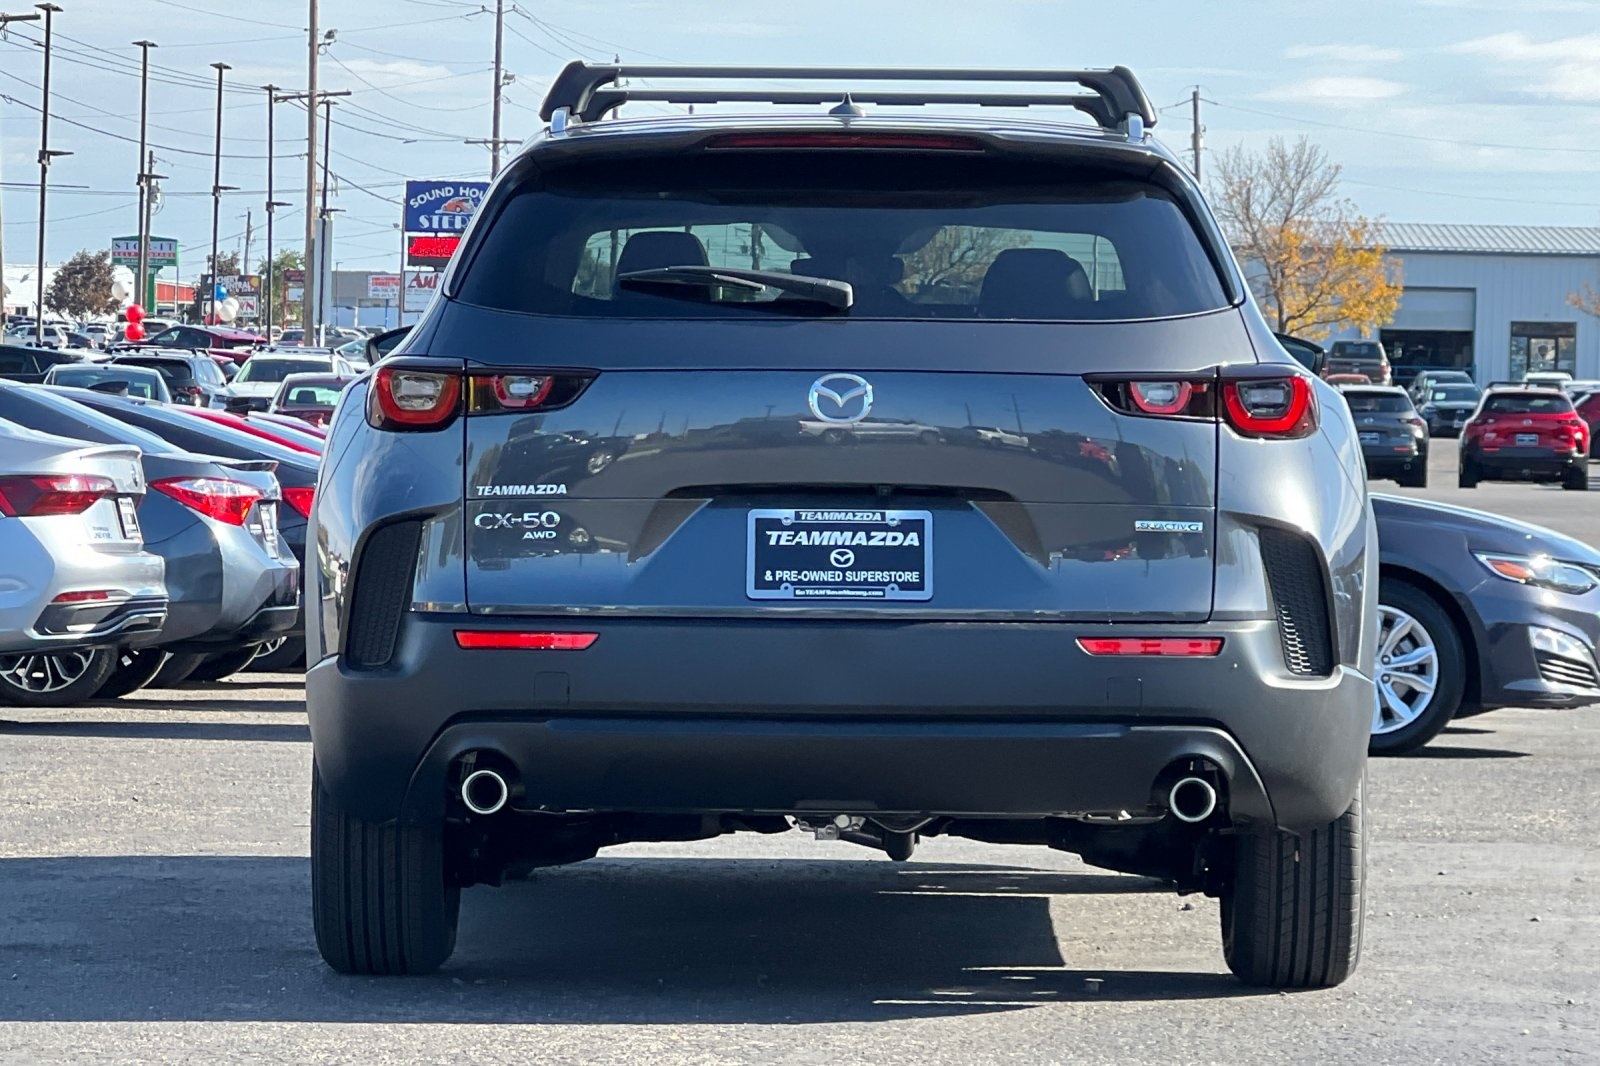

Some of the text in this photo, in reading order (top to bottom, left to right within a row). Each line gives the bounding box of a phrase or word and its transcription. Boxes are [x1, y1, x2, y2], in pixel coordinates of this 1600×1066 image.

[409, 186, 485, 209] SOUND HOU
[418, 214, 472, 229] STER
[407, 271, 439, 288] Aut
[476, 484, 567, 496] TEAMMAZDA
[474, 511, 561, 529] CX-50
[799, 511, 882, 521] TEAMMAZDA
[522, 530, 557, 540] AWD
[766, 531, 920, 546] TEAMMAZDA
[764, 570, 920, 582] & PRE-OWNED SUPERSTORE
